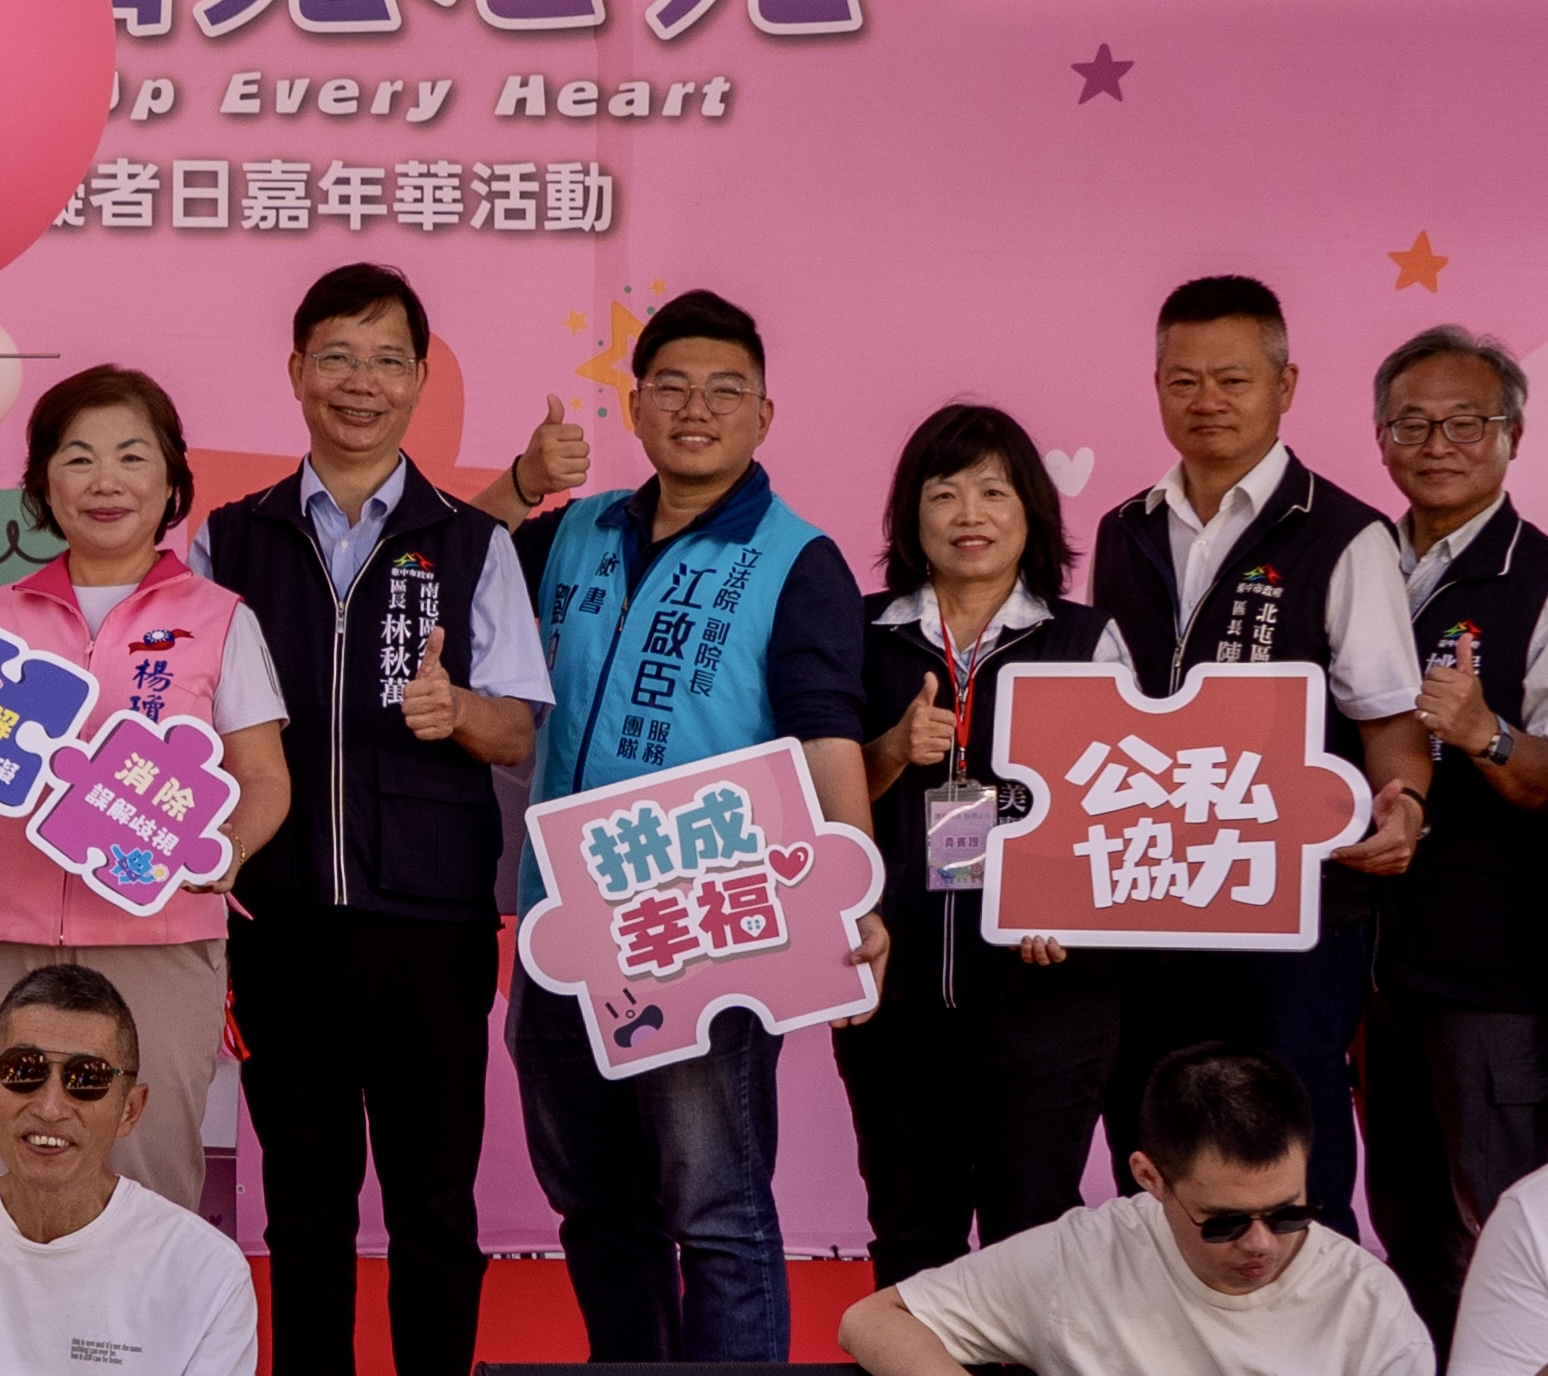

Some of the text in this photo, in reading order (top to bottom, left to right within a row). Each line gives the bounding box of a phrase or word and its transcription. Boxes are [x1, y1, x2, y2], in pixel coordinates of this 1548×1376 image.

[220, 70, 454, 124] Every
[494, 74, 732, 119] Heart
[379, 613, 412, 708] 林秋萬
[689, 546, 763, 698] 立法院 副院長
[1250, 603, 1279, 662] 北屯區
[616, 714, 645, 760] 團隊
[642, 719, 671, 766] 服務
[83, 782, 180, 857] 誤解歧視
[114, 752, 196, 822] 消除
[1063, 734, 1280, 825] 公私
[586, 784, 762, 895] 拼成
[1073, 817, 1278, 908] 協力
[616, 873, 784, 972] 幸福
